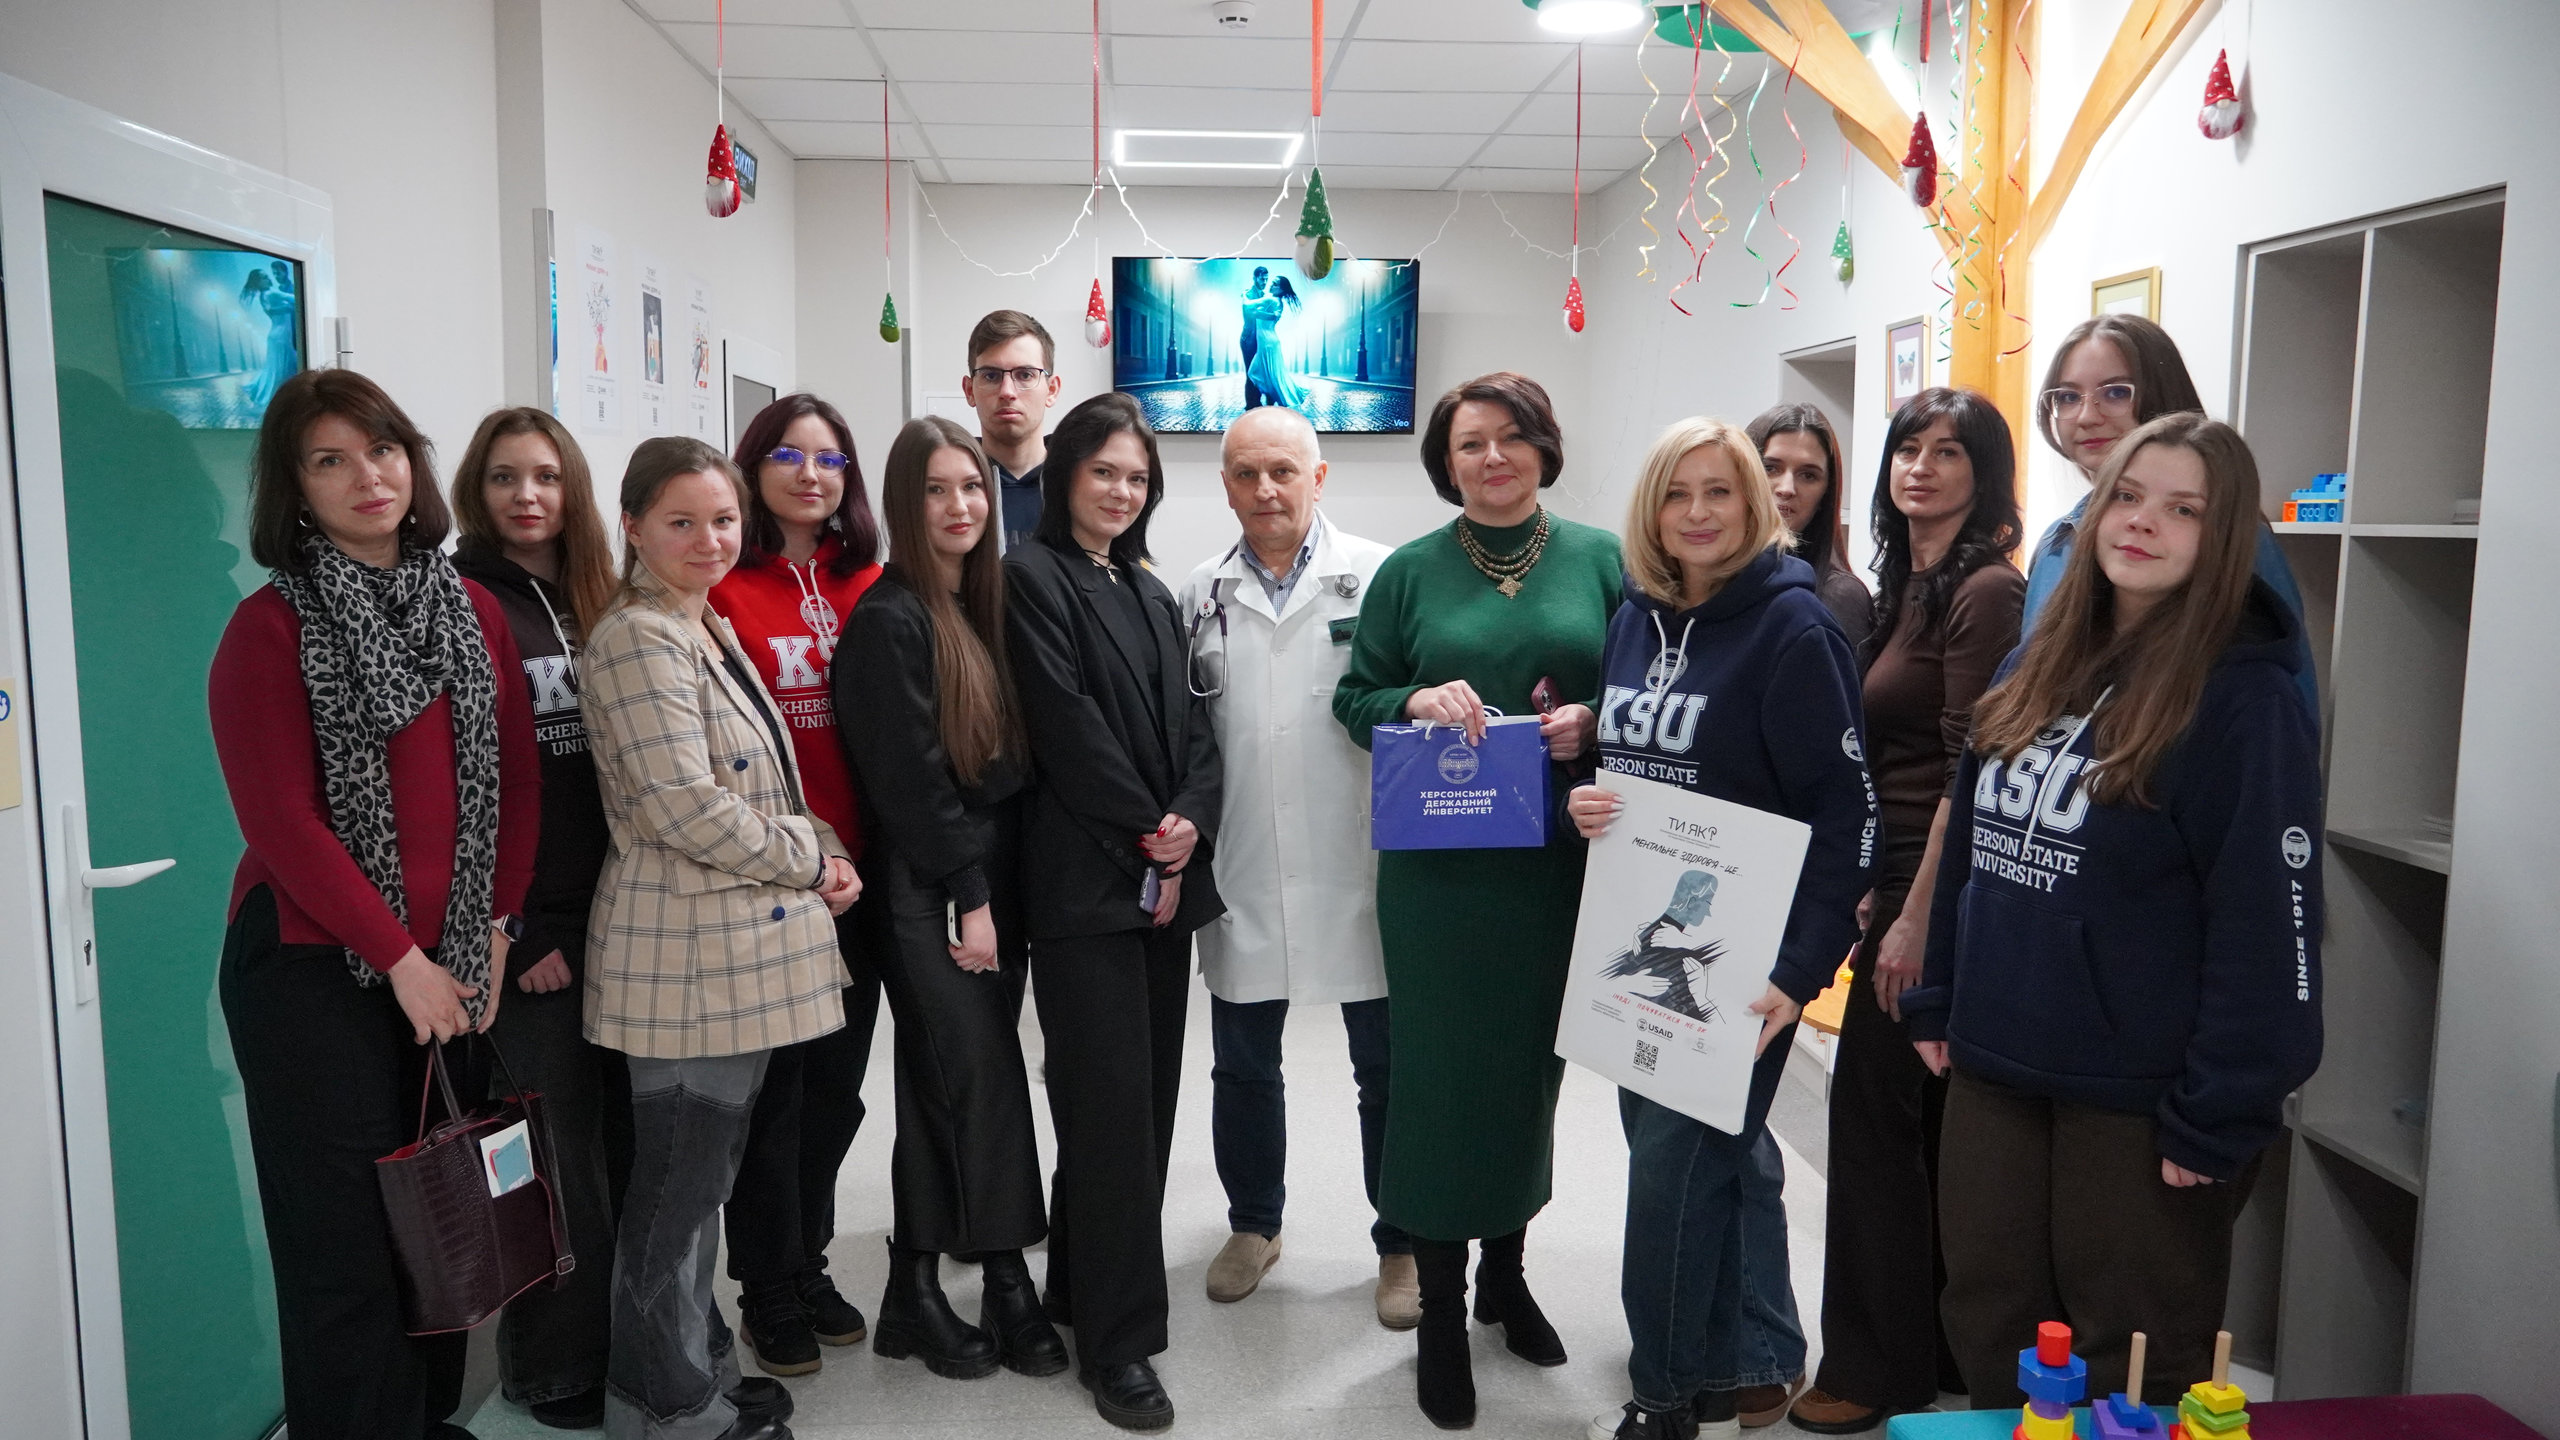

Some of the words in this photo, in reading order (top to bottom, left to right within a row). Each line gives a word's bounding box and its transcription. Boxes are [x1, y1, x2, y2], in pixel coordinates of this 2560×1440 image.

[1393, 419, 1409, 427] Veo
[778, 697, 832, 714] KHERS
[1597, 684, 1708, 754] KSU
[1648, 762, 1698, 785] STATE
[1420, 788, 1497, 799] ХЕРСОНСЬКИЙ
[1861, 770, 1877, 812] 1917
[1423, 806, 1493, 816] УНІВЕРСИТЕТ
[1425, 797, 1491, 809] ДЕРЖАВНИЙ
[1668, 816, 1686, 833] ТИ
[1688, 823, 1718, 841] ЯК?
[1632, 836, 1679, 858] МЕНТАЛЬНЕ
[1859, 816, 1877, 868] SINCE
[2023, 842, 2080, 875] STATE
[2291, 880, 2304, 929] 1917
[2296, 936, 2309, 1002] SINCE
[1648, 1023, 1674, 1040] USAID
